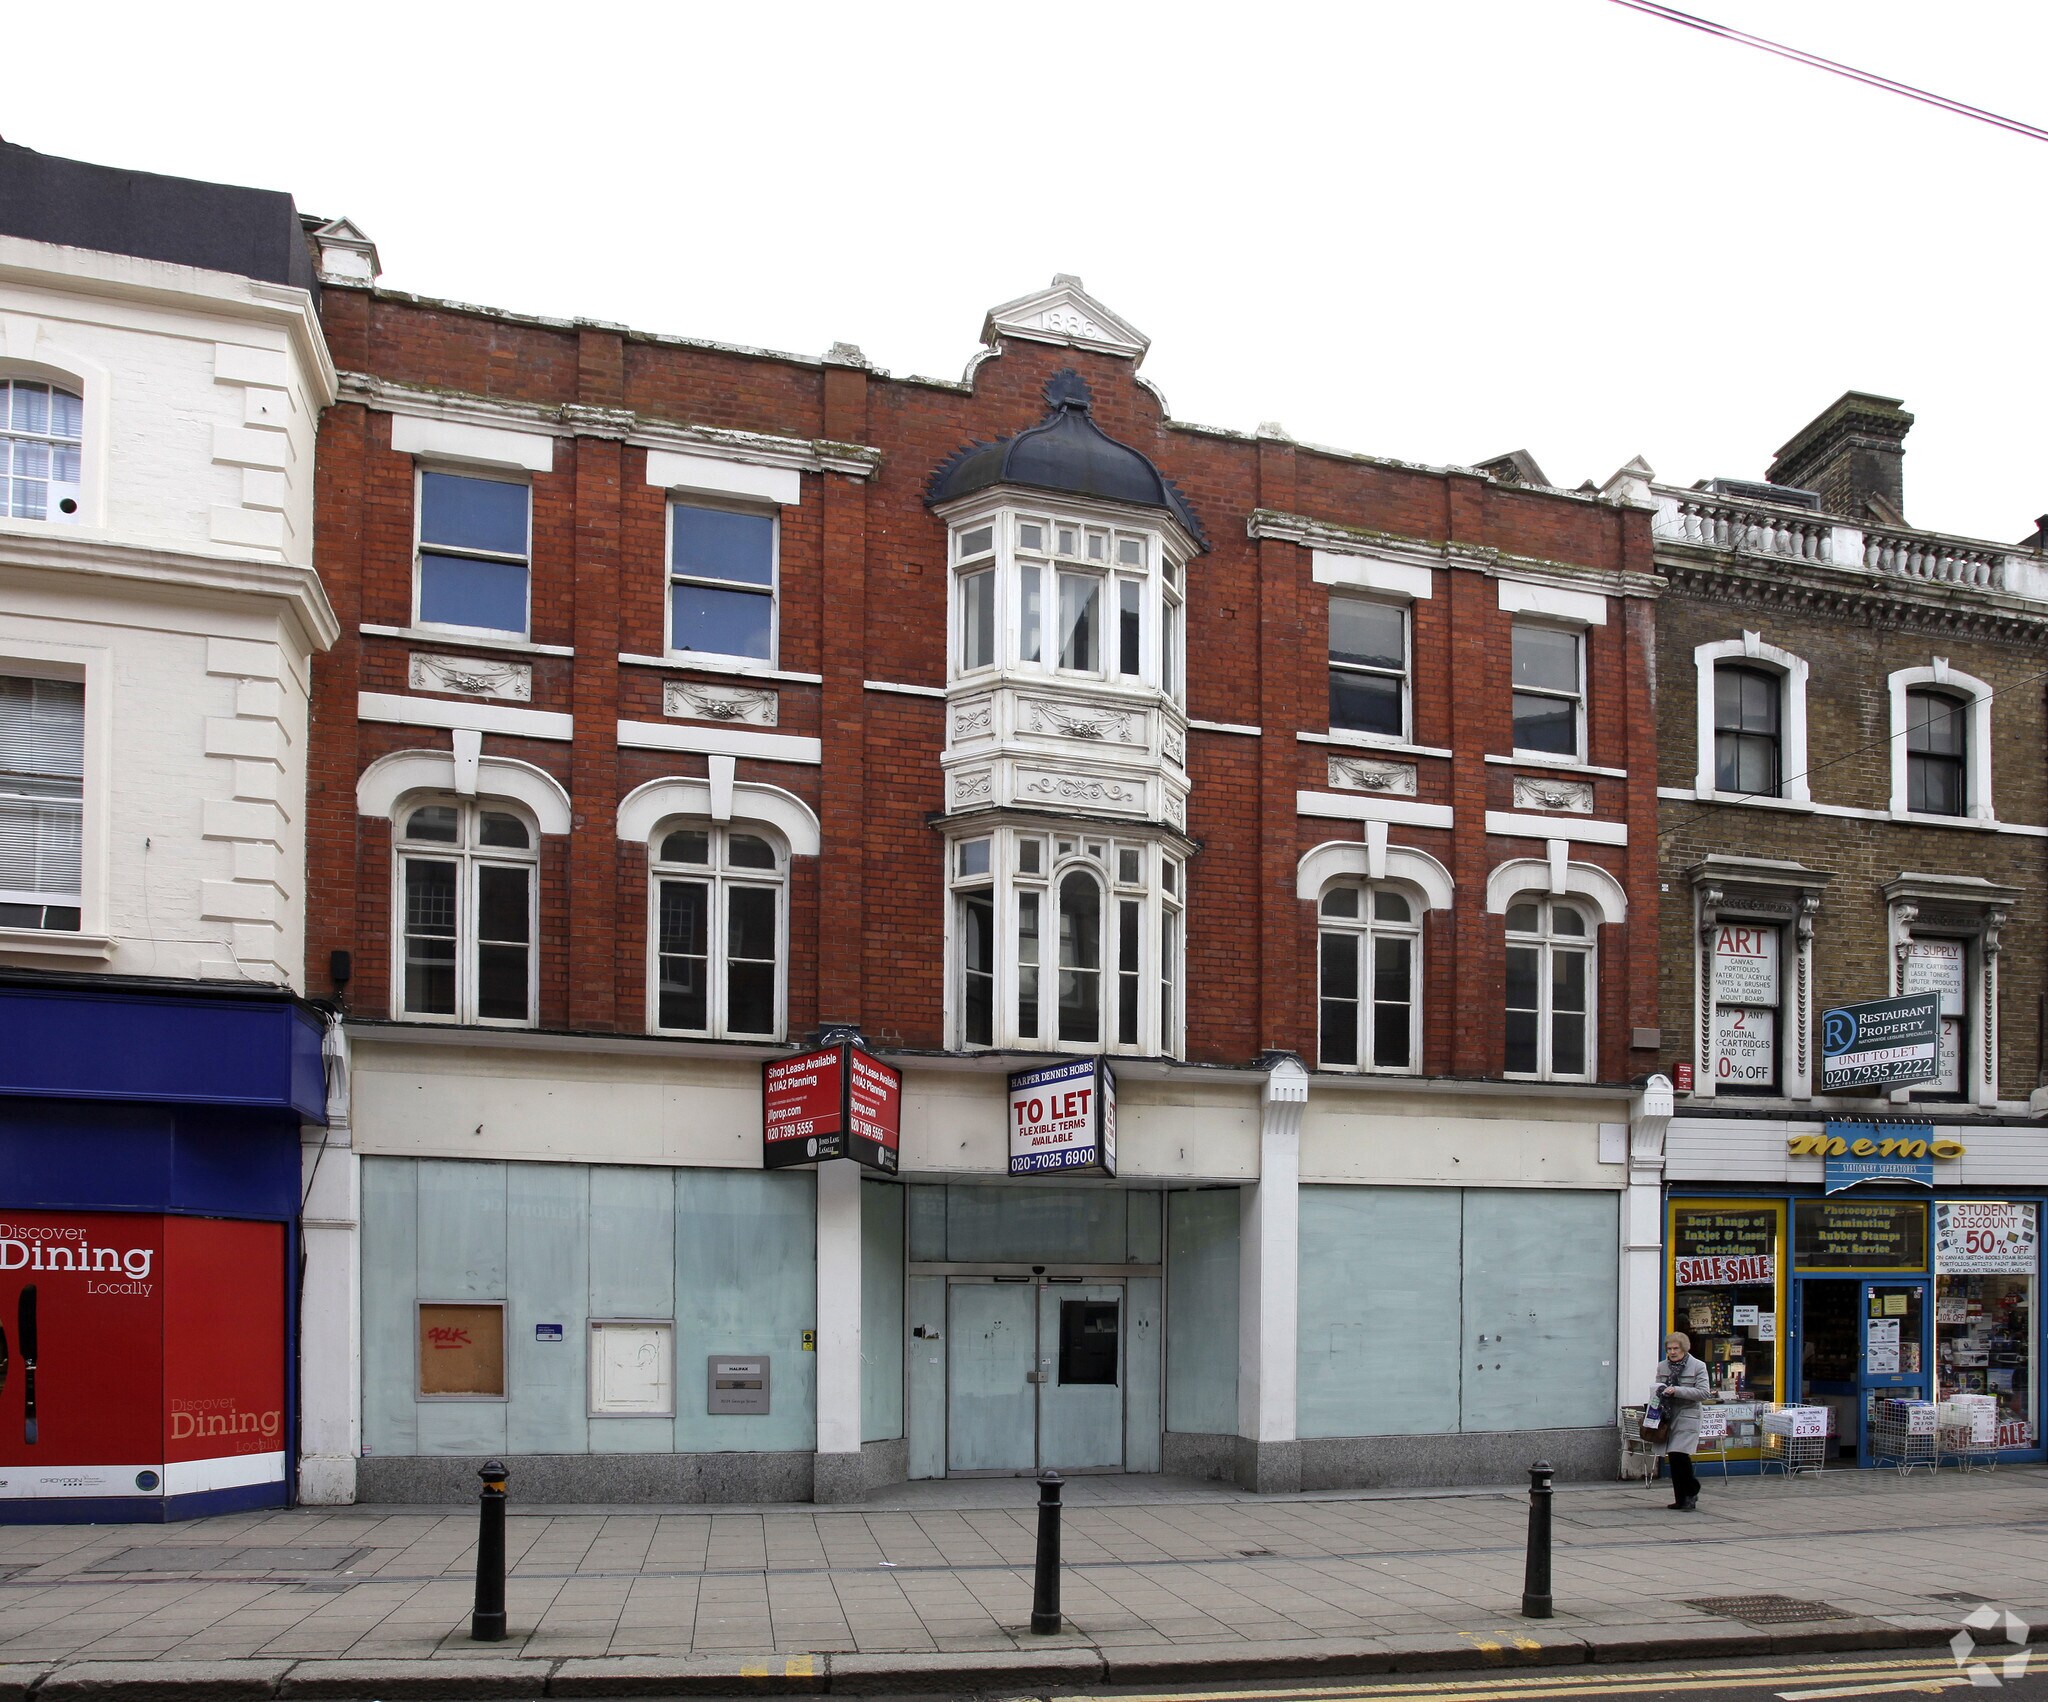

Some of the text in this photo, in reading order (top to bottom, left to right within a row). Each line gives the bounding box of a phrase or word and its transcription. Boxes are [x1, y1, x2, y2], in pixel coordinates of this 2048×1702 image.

[1041, 312, 1096, 338] 1886
[1716, 926, 1768, 954] ART
[1923, 945, 1958, 957] SUPPLY
[1730, 958, 1754, 966] CANVAS
[1734, 1009, 1745, 1030] 2
[1748, 1012, 1764, 1020] ANY
[1720, 1030, 1756, 1039] ORIGINAL
[1944, 1022, 1952, 1035] 2
[1858, 1030, 1933, 1044] NATIONWIDE LEISURE SPECIALISTS
[1838, 1046, 1918, 1066] UNIT TO LET
[768, 1054, 836, 1079] Shop Lease Available
[852, 1057, 898, 1090] Shop Lease Available
[1746, 1066, 1768, 1079] OFF
[1826, 1069, 1850, 1084] 020
[1854, 1064, 1890, 1080] 7935
[1893, 1058, 1932, 1076] 2222
[788, 1074, 817, 1089] Planning
[1012, 1062, 1094, 1088] HARPER DENNIS HOBBS
[866, 1081, 887, 1101] Planning
[1014, 1089, 1092, 1126] TO LET
[767, 1121, 813, 1140] 020 7399 5555
[860, 1120, 871, 1136] 7399
[872, 1126, 884, 1141] 5555
[1020, 1118, 1086, 1137] FLEXIBLE TERMS
[1032, 1132, 1073, 1147] AVAILABLE
[1787, 1134, 1967, 1159] memo
[1011, 1153, 1062, 1172] 020-7025
[1065, 1148, 1095, 1165] 6900
[1842, 1164, 1917, 1173] STATIONERY SUPERSTORES
[1824, 1206, 1896, 1217] Photocopying
[1958, 1204, 2016, 1216] STUDENT
[1688, 1216, 1765, 1228] Best Range of
[1829, 1218, 1890, 1229] Laminating
[1952, 1217, 2018, 1228] DISCOUNT
[0, 1224, 86, 1240] Discover
[1685, 1230, 1767, 1242] Inkjet & Laser
[1818, 1231, 1900, 1242] Rubber Stamps
[1696, 1244, 1756, 1255] Cartridges
[1829, 1244, 1890, 1253] Fax Service
[1955, 1246, 1965, 1254] TO
[1966, 1230, 2007, 1254] 50%
[2012, 1246, 2029, 1254] OFF
[0, 1240, 154, 1280] Dining
[1680, 1256, 1768, 1283] SALE SALE
[88, 1281, 153, 1298] Locally
[172, 1398, 235, 1412] Discover
[171, 1408, 280, 1439] Dining
[1796, 1425, 1820, 1434] £1.99
[2000, 1422, 2026, 1446] ALE
[236, 1438, 280, 1452] Locally
